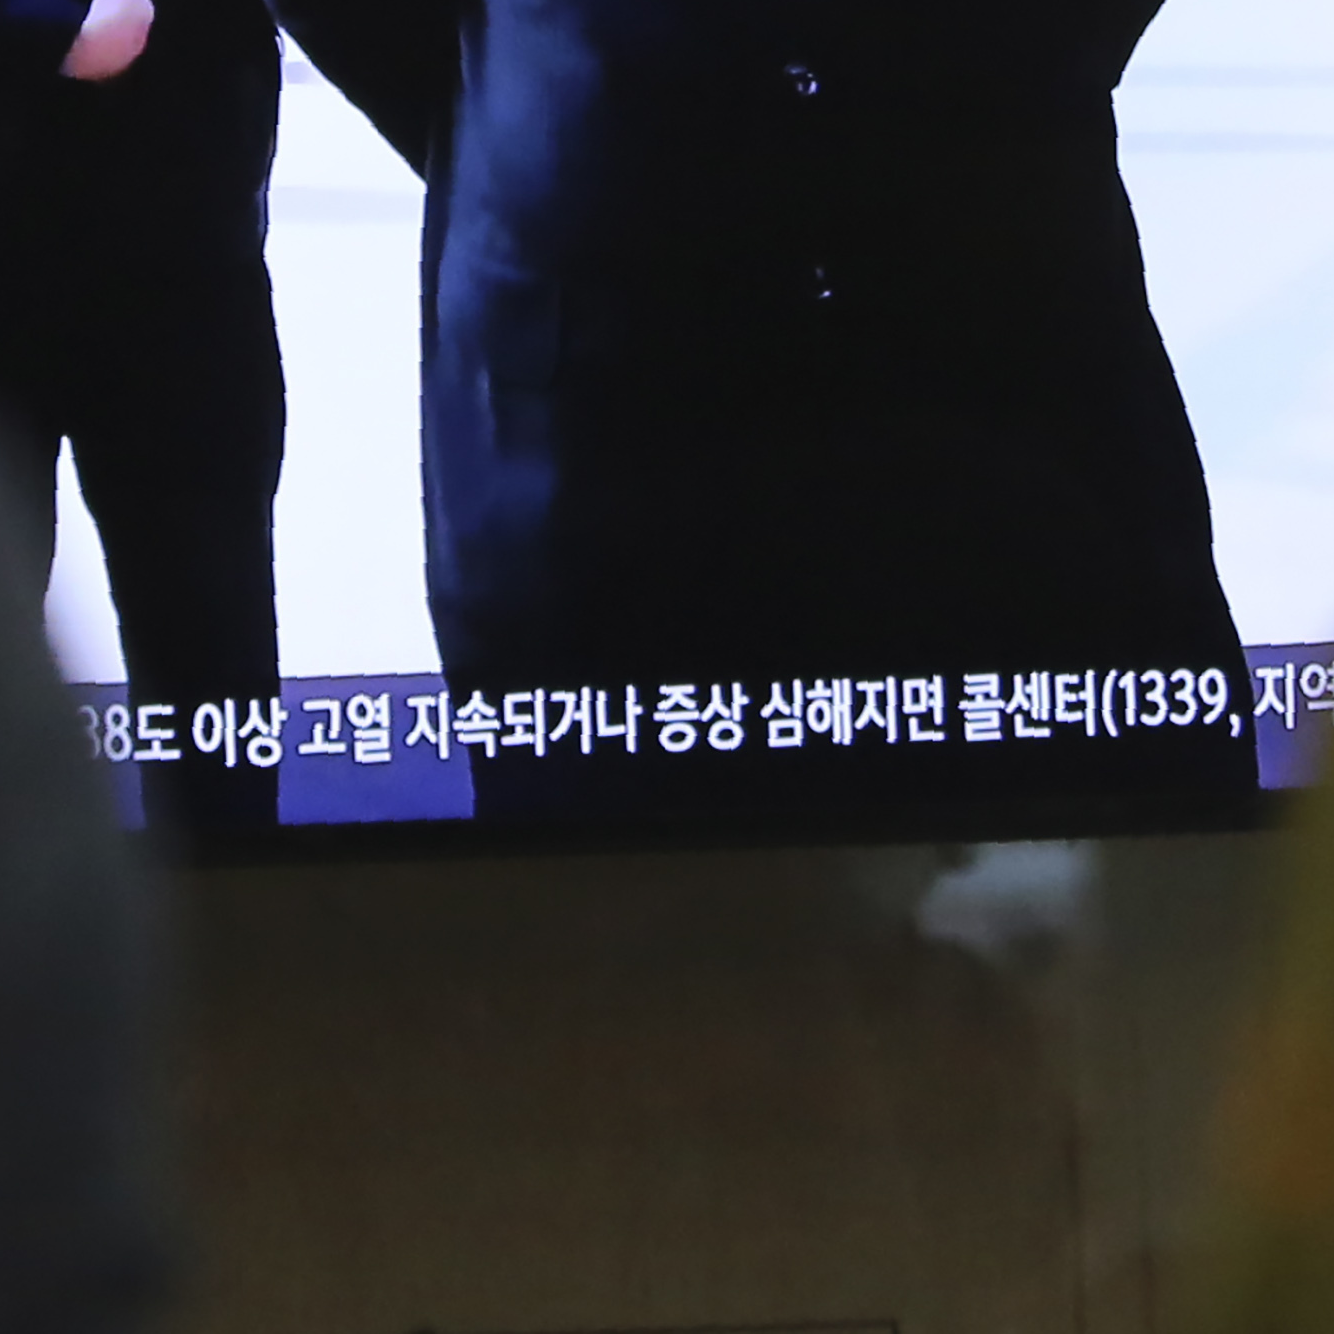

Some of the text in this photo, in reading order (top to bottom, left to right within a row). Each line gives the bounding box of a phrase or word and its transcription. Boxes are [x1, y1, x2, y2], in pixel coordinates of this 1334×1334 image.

[191, 697, 289, 767] 이상
[297, 692, 393, 763] 고열
[404, 683, 643, 760] 지속되거나
[652, 682, 749, 751] 증상
[760, 674, 945, 747] 심해지면
[958, 668, 1241, 741] 콜센터(1339,
